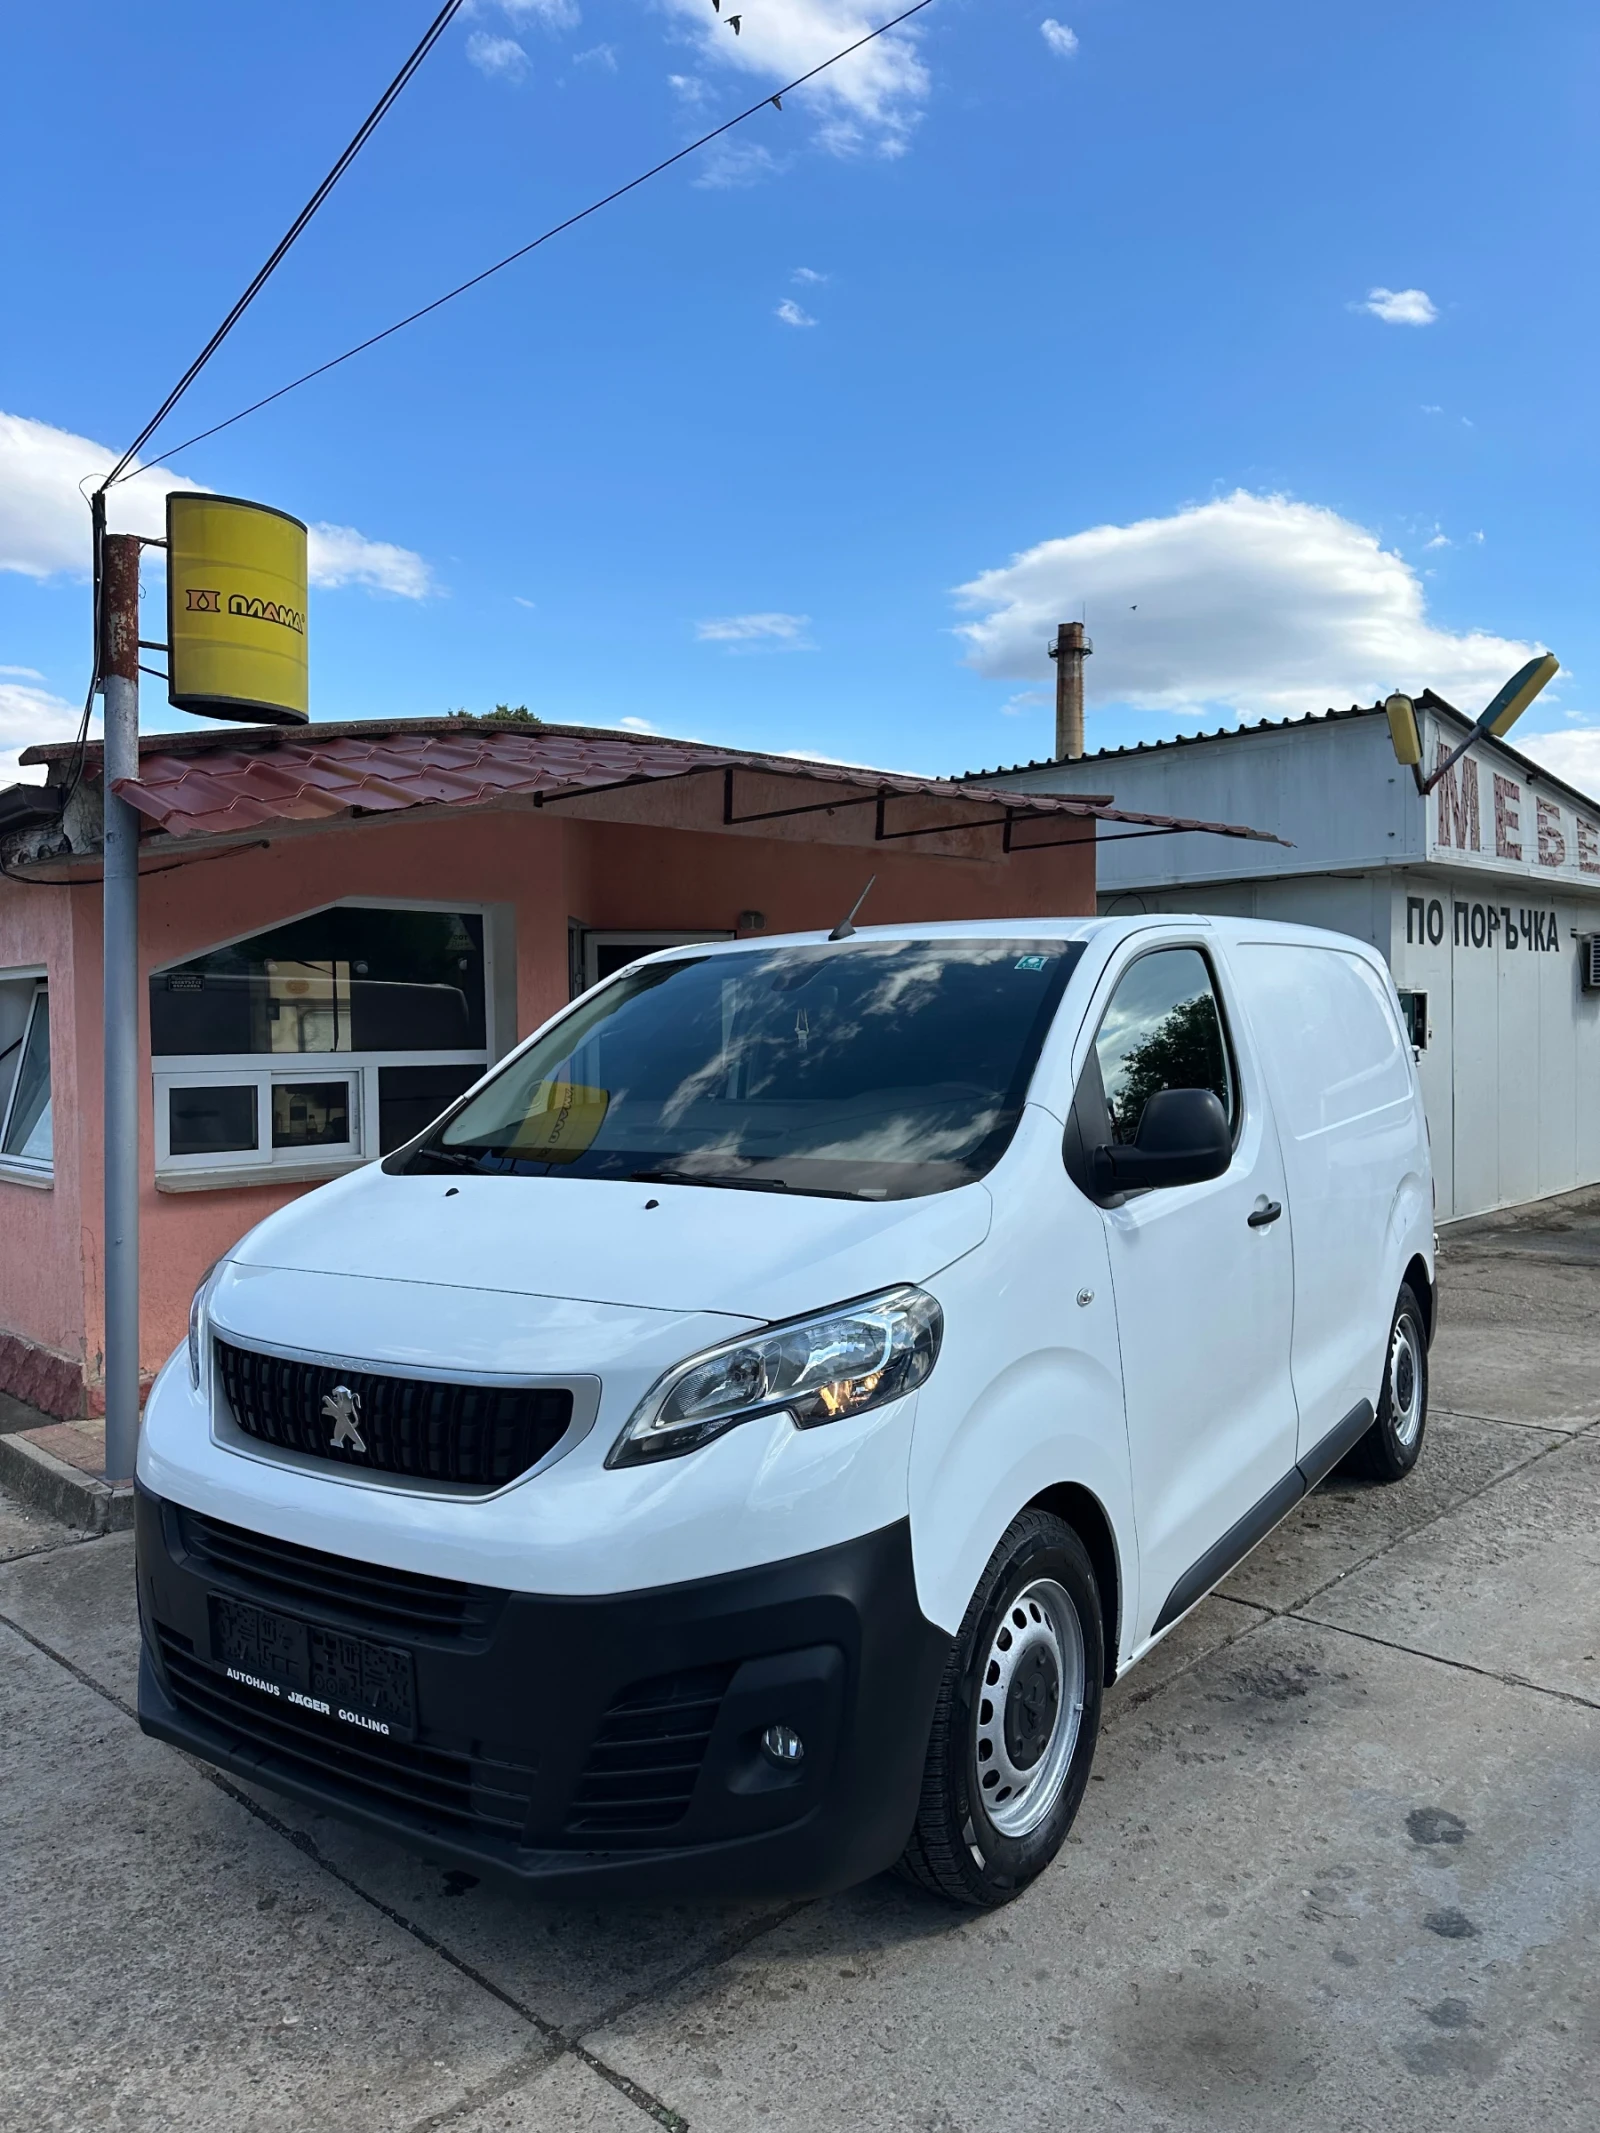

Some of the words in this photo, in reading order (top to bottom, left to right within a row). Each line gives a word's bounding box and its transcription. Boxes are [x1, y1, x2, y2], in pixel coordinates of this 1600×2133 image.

[1406, 896, 1444, 946] ПО
[1454, 901, 1560, 952] ПОРЪЧКА
[312, 1354, 381, 1371] PEUGEOT
[226, 1667, 281, 1696] AUTOHAUS
[287, 1691, 331, 1716] JÄGER
[338, 1708, 390, 1736] GOLLING
